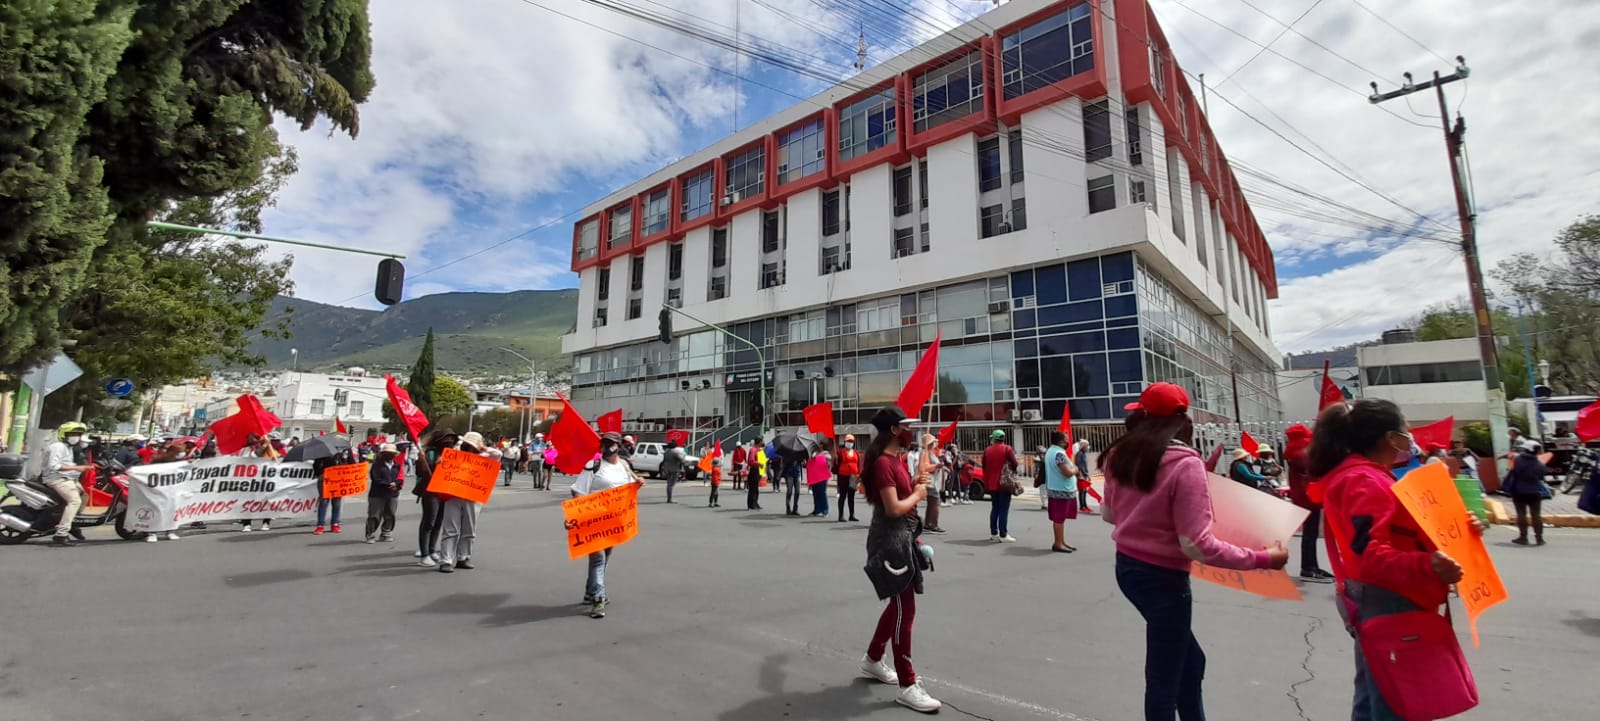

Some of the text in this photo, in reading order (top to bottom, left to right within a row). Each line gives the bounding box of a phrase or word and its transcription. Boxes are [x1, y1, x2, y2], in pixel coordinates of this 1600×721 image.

[147, 472, 188, 488] Omar
[189, 464, 230, 481] Fayad
[233, 464, 258, 478] no
[261, 465, 276, 478] le
[200, 479, 276, 493] al pueblo
[328, 485, 365, 497] TODOS
